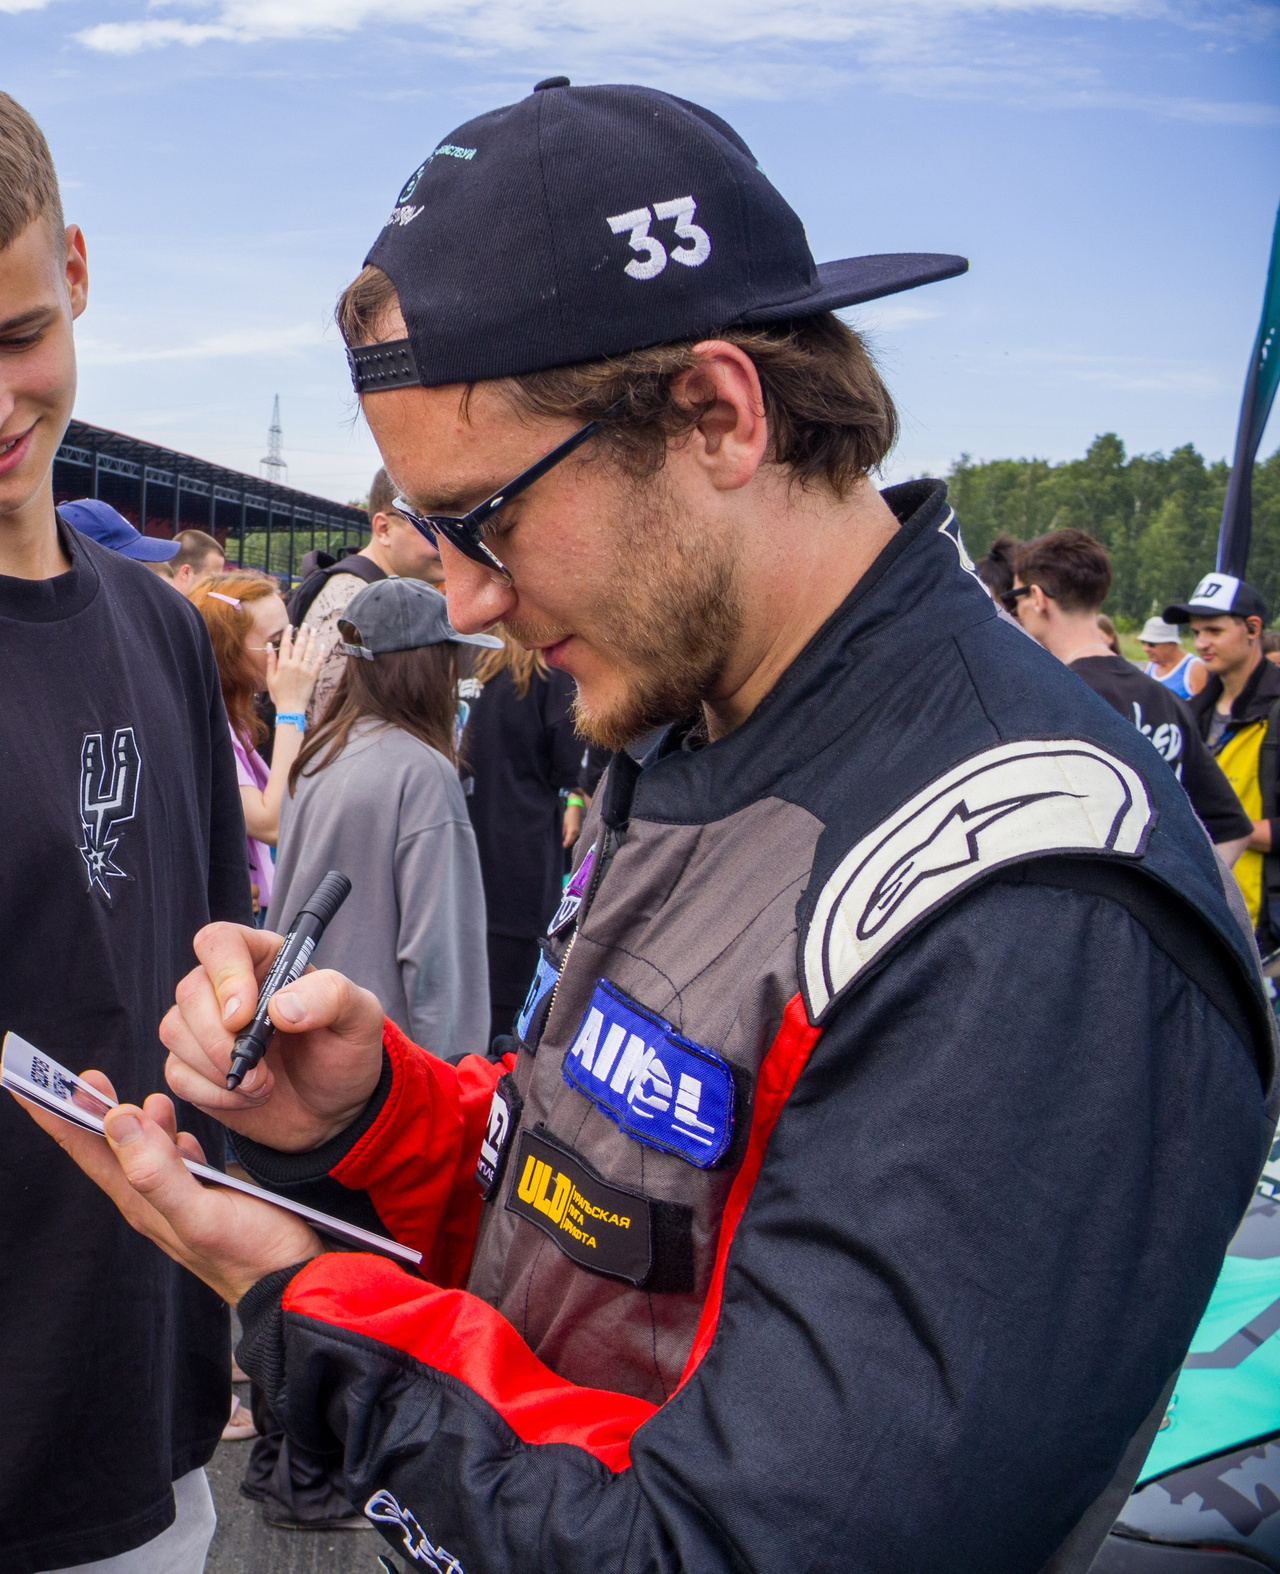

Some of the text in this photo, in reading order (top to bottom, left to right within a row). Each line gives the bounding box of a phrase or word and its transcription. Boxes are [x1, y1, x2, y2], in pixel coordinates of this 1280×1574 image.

[606, 195, 711, 280] 33
[517, 1154, 572, 1224] ULD
[572, 1190, 631, 1229] УРАЛЬСКАЯ
[562, 1217, 597, 1249] ДРИФТА
